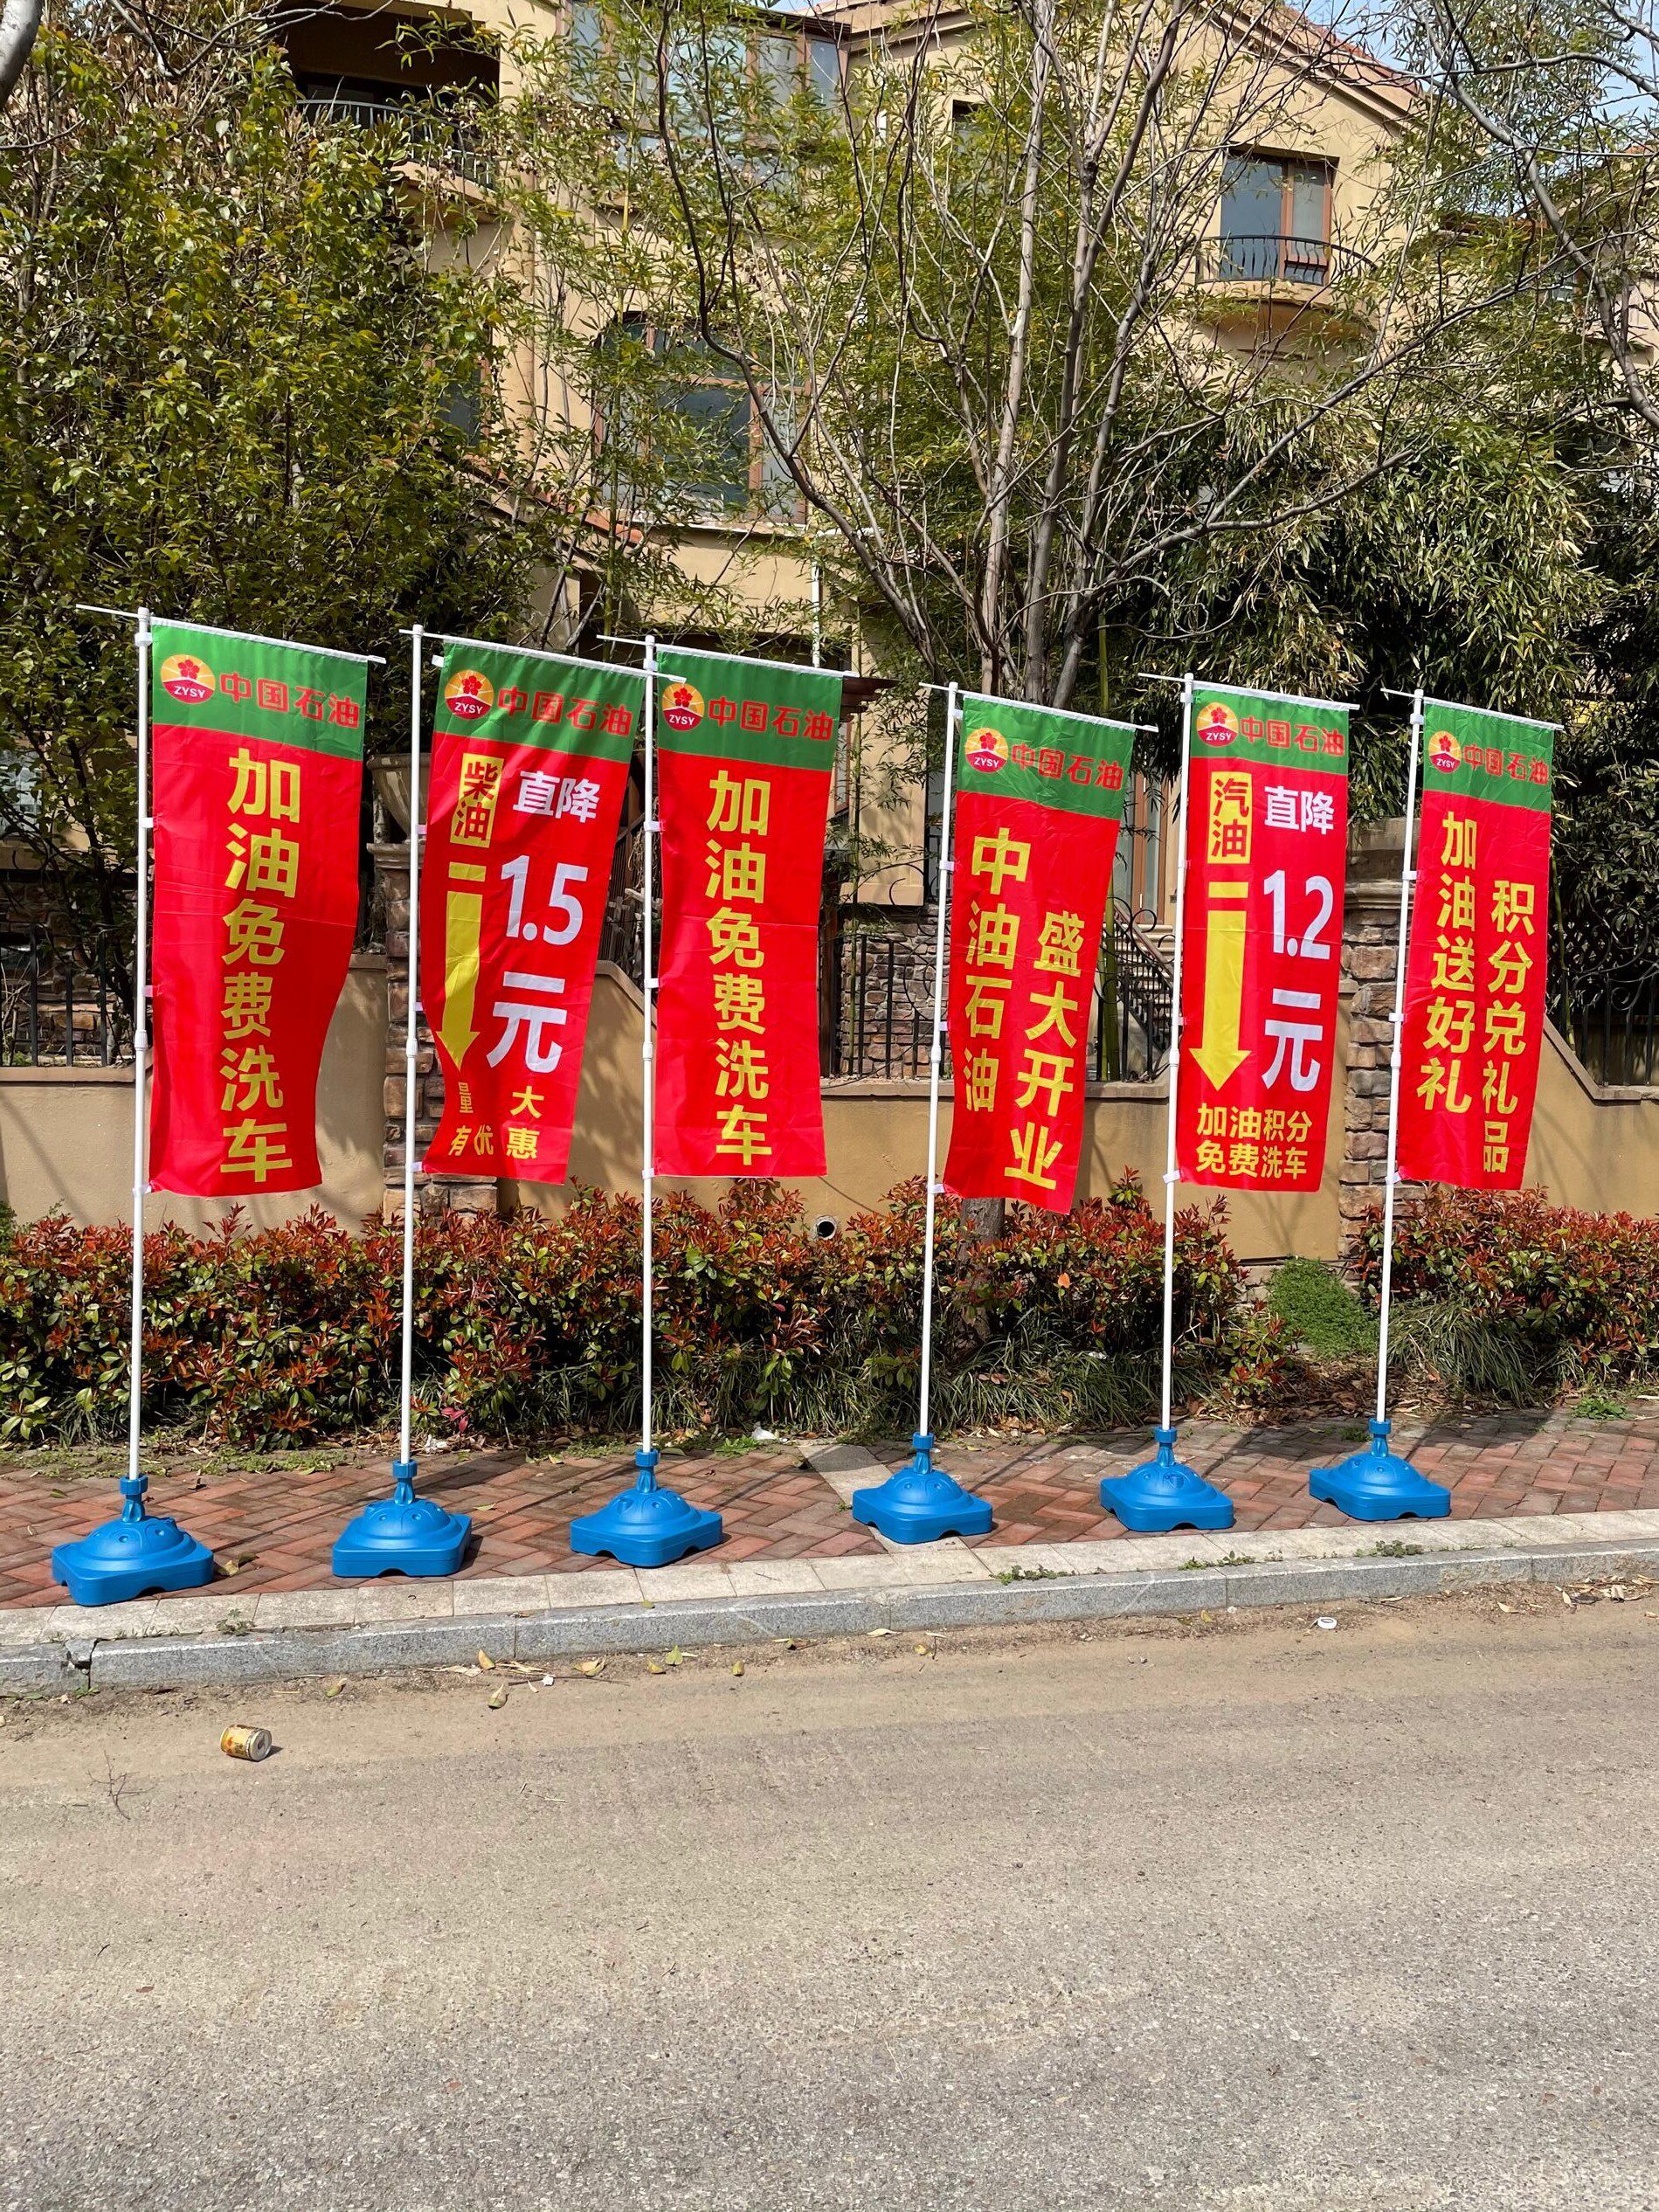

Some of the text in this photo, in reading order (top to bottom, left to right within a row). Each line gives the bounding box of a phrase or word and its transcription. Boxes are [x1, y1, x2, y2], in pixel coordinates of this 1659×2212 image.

[173, 686, 206, 700] ZYSY
[221, 671, 360, 729] 中国石油
[455, 702, 483, 715] ZYSY
[498, 686, 632, 736] 中国石油
[668, 714, 694, 727] ZYSY
[708, 696, 833, 742] 中国石油
[1205, 731, 1233, 742] ZYSY
[1241, 715, 1344, 757] 中国石油
[973, 756, 999, 769] ZYSY
[1012, 743, 1124, 791] 中国石油
[1436, 758, 1456, 769] ZYSY
[1463, 744, 1549, 785] 中国石油
[455, 761, 499, 841] 柴油
[513, 771, 600, 823] 直降
[1212, 777, 1249, 859] 汽油
[1264, 785, 1335, 834] 直降
[501, 855, 589, 945] 1.5
[1263, 869, 1333, 961] 1.2
[220, 748, 301, 1182] 加油免费洗车
[705, 770, 771, 1165] 加油免费洗车
[963, 827, 1030, 1113] 中油石油
[1416, 811, 1477, 1114] 加油送好礼
[487, 971, 568, 1074] 元
[1262, 989, 1323, 1092] 元
[1482, 879, 1535, 1173] 积分兑礼品
[1004, 910, 1085, 1190] 盛大开业
[1197, 1103, 1312, 1143] 加油积分
[1196, 1139, 1308, 1180] 免费洗车
